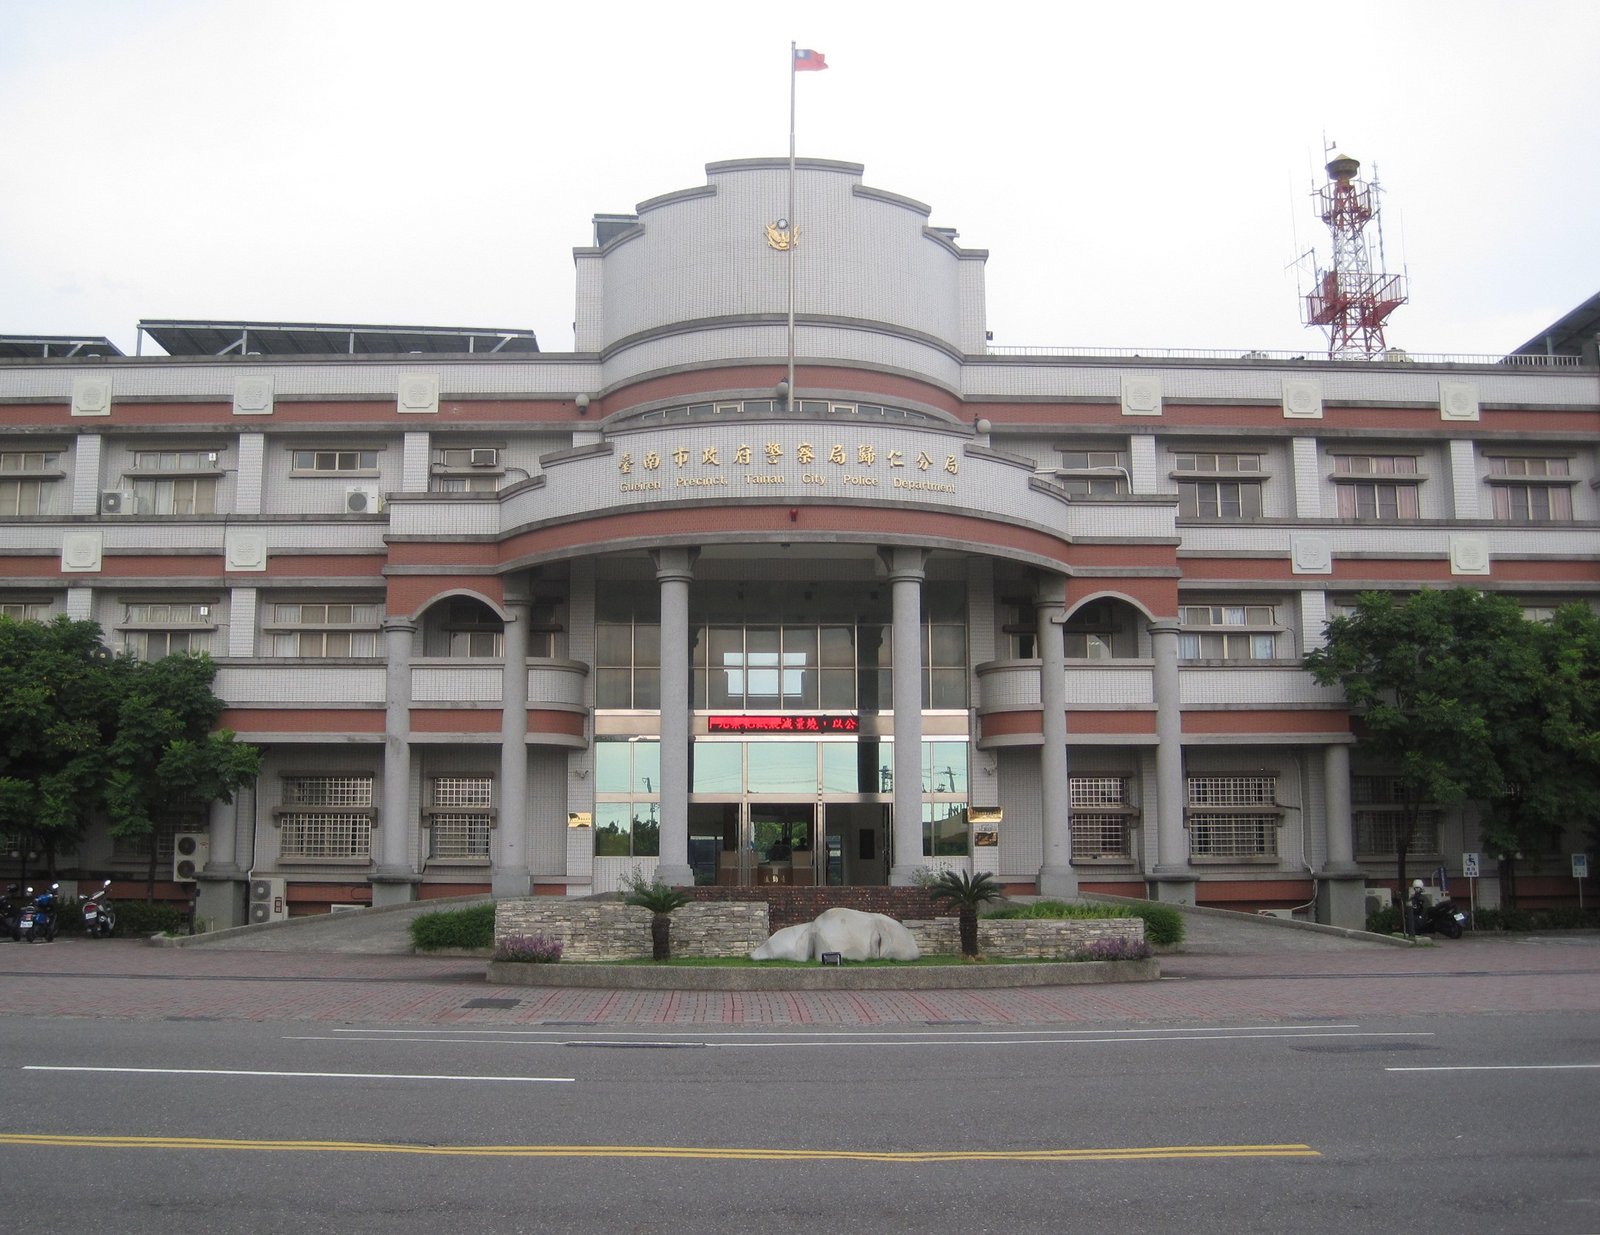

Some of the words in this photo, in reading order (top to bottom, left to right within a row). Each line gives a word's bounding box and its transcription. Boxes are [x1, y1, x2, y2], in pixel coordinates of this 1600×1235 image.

[618, 441, 959, 475] 臺南市政府警察局歸仁分局
[619, 480, 661, 493] Gueiren
[744, 473, 785, 485] Tainan
[802, 473, 826, 486] City
[843, 474, 879, 487] Police
[893, 477, 956, 494] Department
